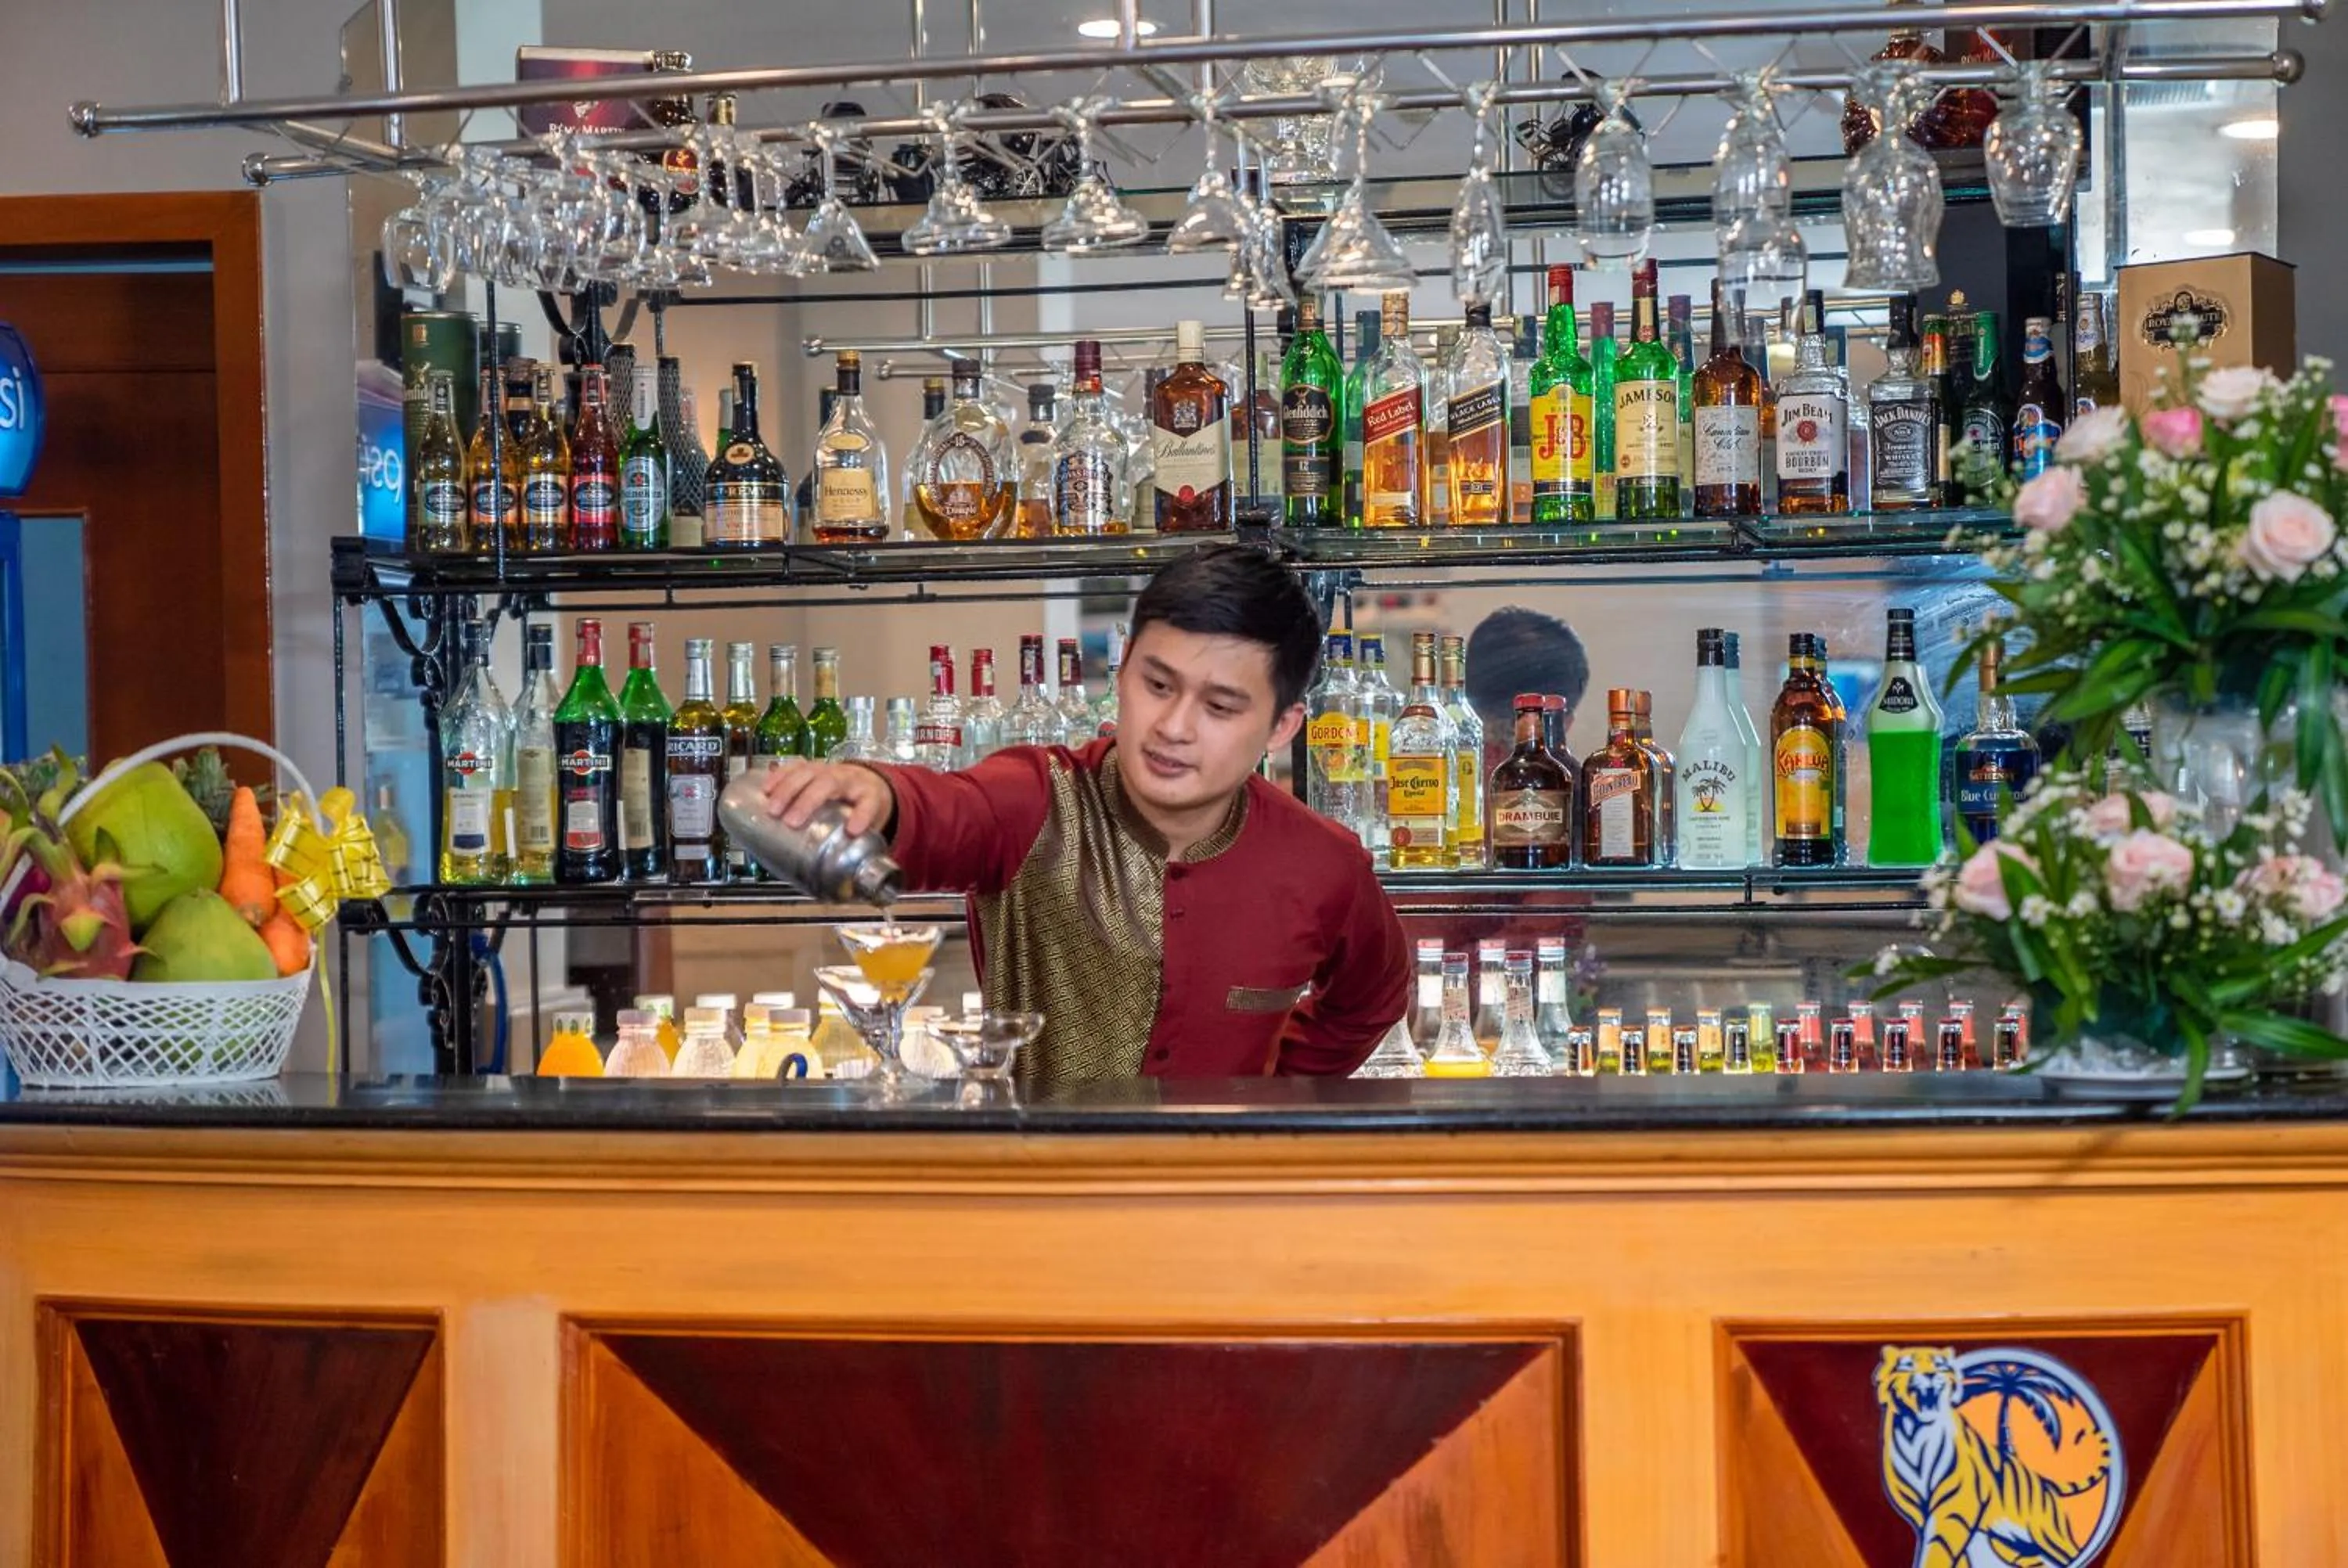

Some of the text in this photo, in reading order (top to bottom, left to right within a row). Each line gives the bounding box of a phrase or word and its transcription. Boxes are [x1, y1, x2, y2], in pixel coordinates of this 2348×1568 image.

[2148, 315, 2173, 329] ROYA
[1781, 403, 1833, 426] JIM BEAM
[1874, 409, 1896, 429] JACK
[1785, 455, 1830, 469] BOURBON
[824, 485, 869, 500] Hennessy
[916, 728, 956, 741] IRNOFF
[1311, 725, 1362, 740] GORDON
[447, 759, 492, 768] MARTINI
[561, 757, 607, 766] MARTINI
[1682, 760, 1736, 782] MALIBU
[1961, 789, 1982, 802] Blue
[1499, 811, 1561, 822] DRAMBUIE
